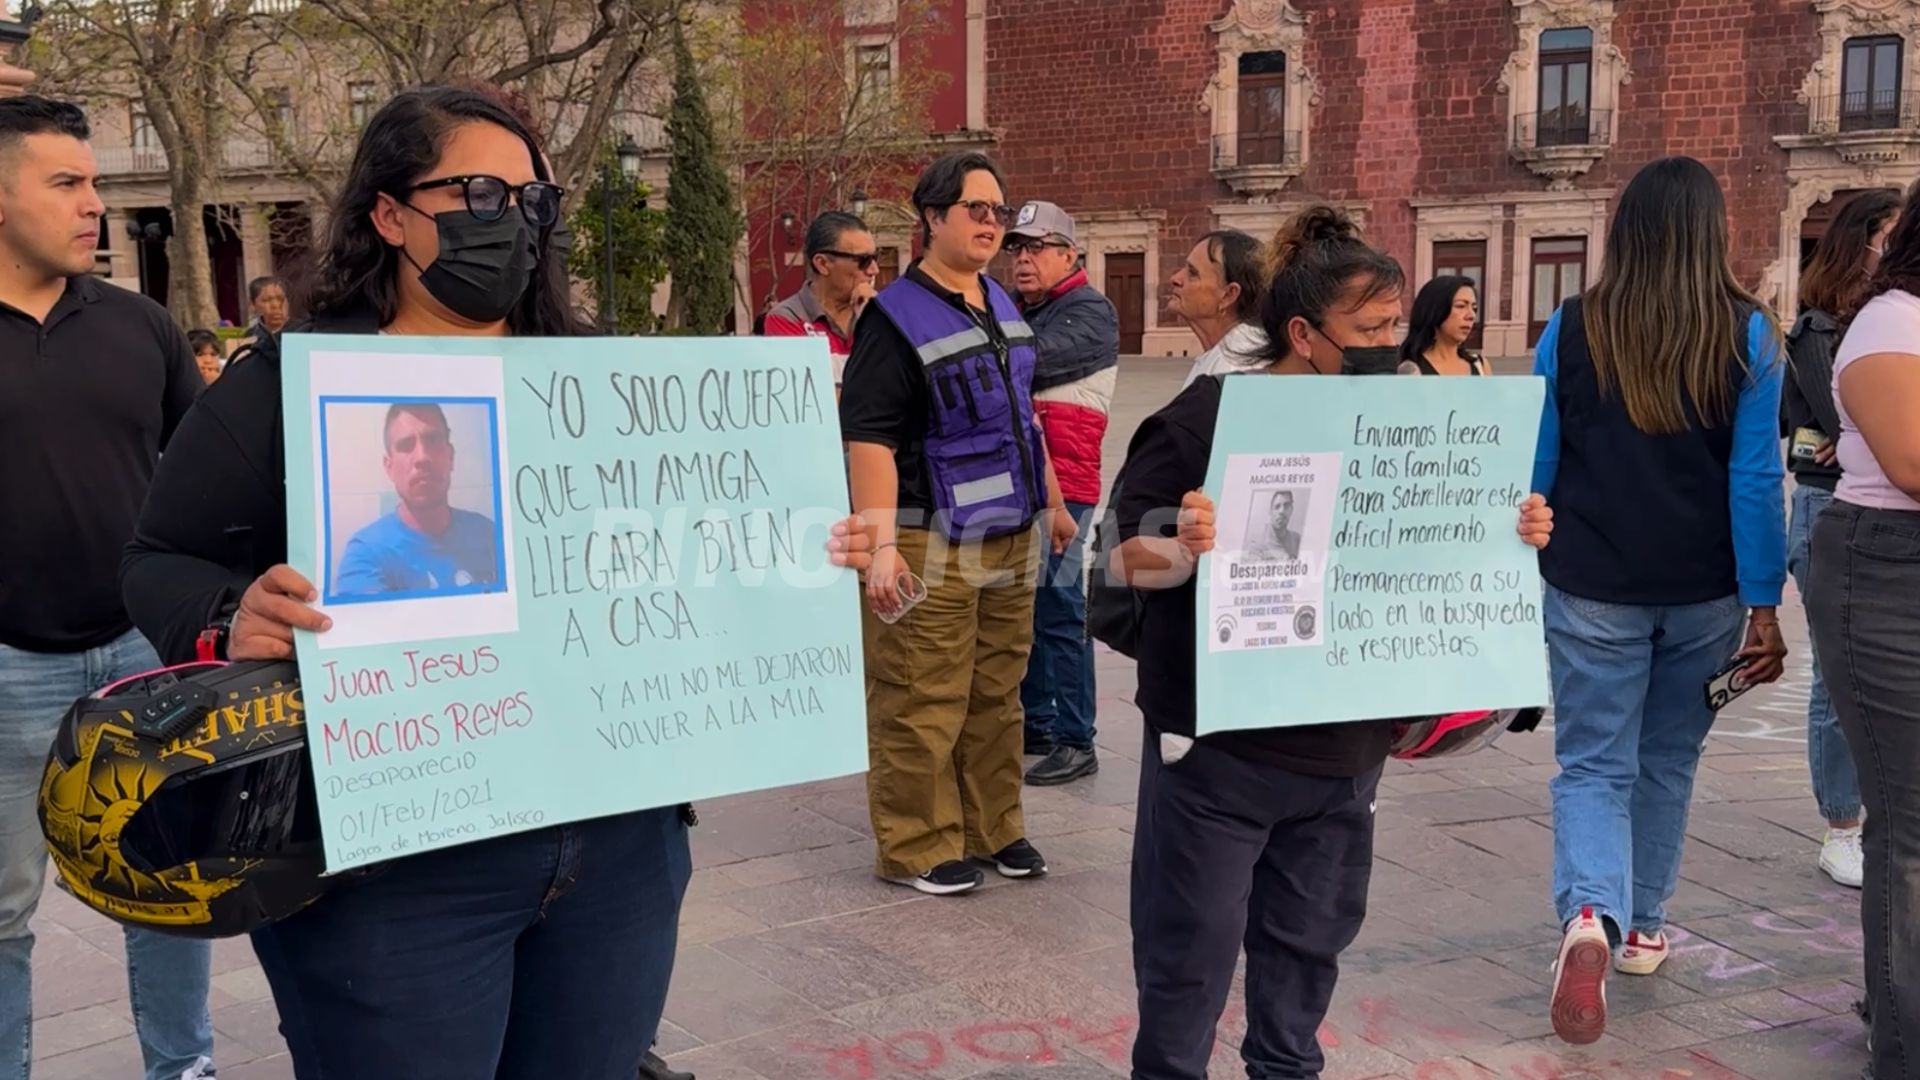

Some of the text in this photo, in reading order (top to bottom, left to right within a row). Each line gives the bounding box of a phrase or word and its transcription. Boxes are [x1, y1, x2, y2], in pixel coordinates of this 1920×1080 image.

[521, 366, 823, 440] YO SOLO QUERIA
[1354, 414, 1436, 447] Enviamos
[1249, 473, 1315, 485] MACIAS REYES
[1259, 457, 1282, 468] JUAN
[1348, 450, 1482, 479] a las familias
[515, 449, 770, 528] QUE MI AMIGA
[1488, 482, 1523, 509] este
[1335, 513, 1486, 549] dificil momento
[525, 507, 795, 598] LLEGARA BIEN
[1229, 560, 1308, 580] Desaparecido
[1331, 563, 1464, 595] Permanecemos
[1470, 572, 1483, 593] a
[1330, 592, 1540, 632] lado en la busqueda
[563, 608, 590, 658] A
[1326, 629, 1480, 667] de respuestas
[321, 660, 395, 703] Juan
[590, 644, 852, 713] Y A MI NO ME DEJARON
[323, 690, 534, 766] Macias Reyes
[596, 685, 825, 750] VOLVER A LA MIA
[337, 845, 383, 864] Lagos
[391, 834, 409, 851] de
[488, 809, 545, 831] Jalisco
